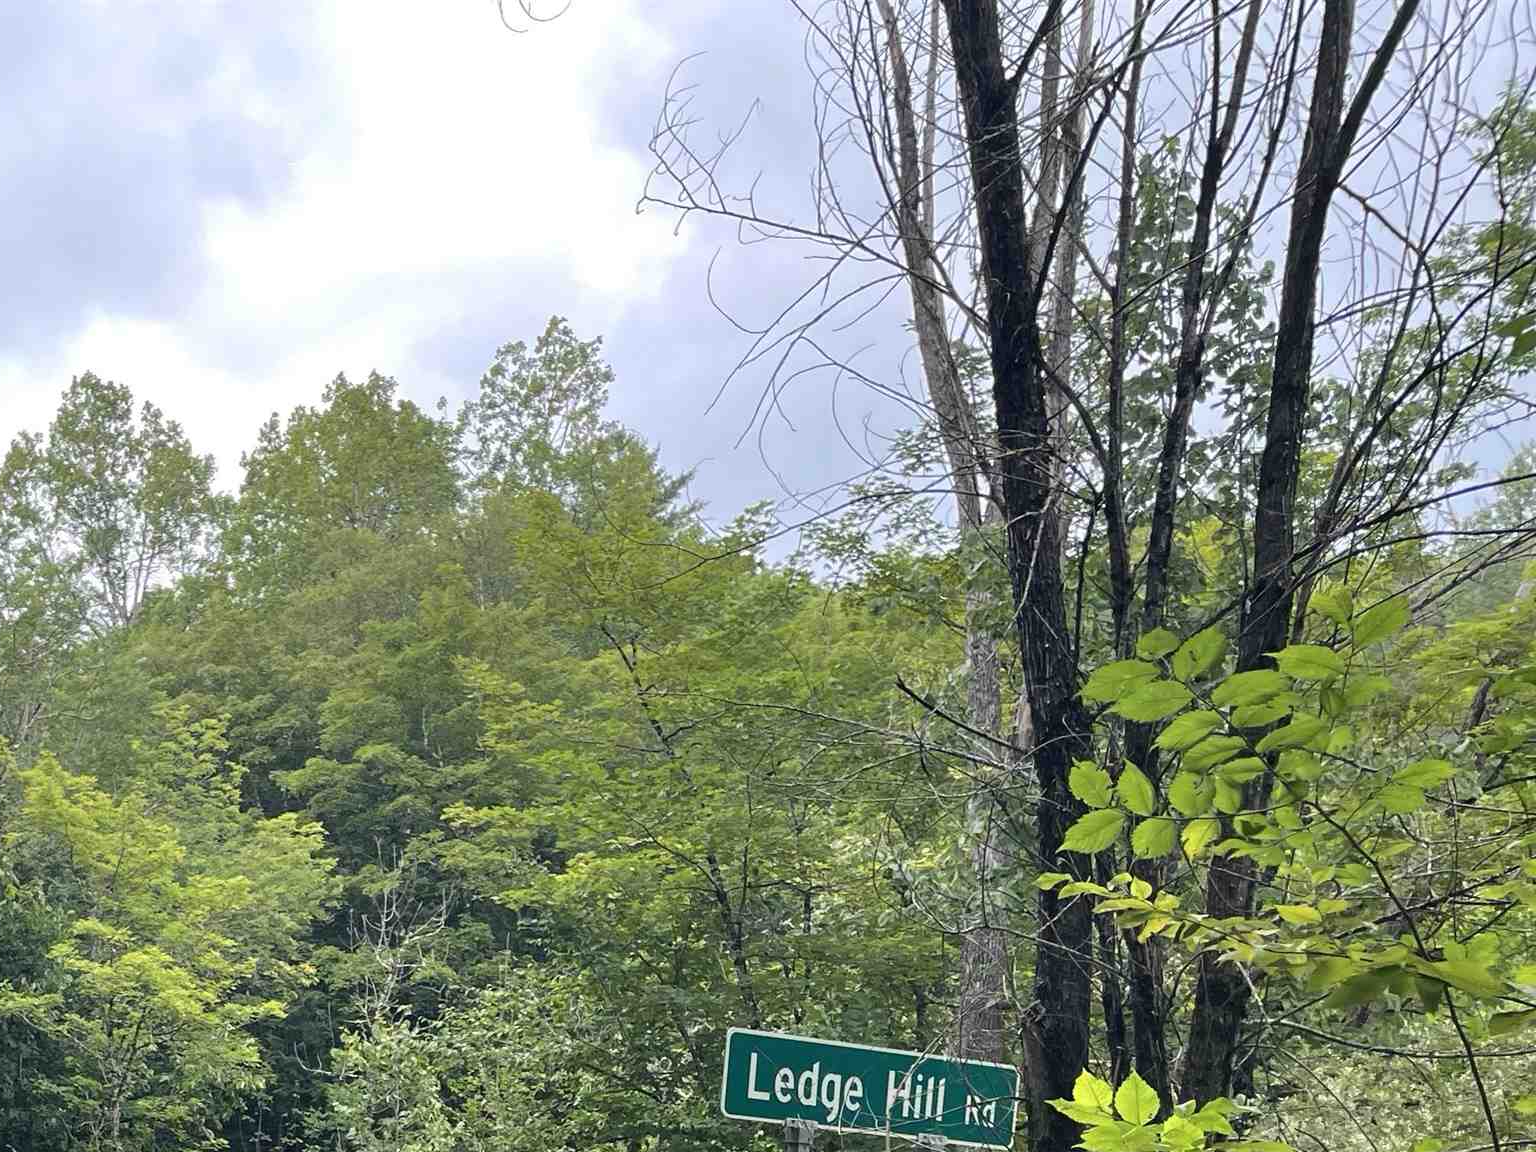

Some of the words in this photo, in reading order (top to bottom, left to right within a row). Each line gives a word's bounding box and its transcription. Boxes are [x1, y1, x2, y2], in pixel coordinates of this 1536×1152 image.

[748, 1052, 863, 1122] Ledge
[887, 1071, 945, 1121] Hill
[964, 1095, 996, 1128] Rd
